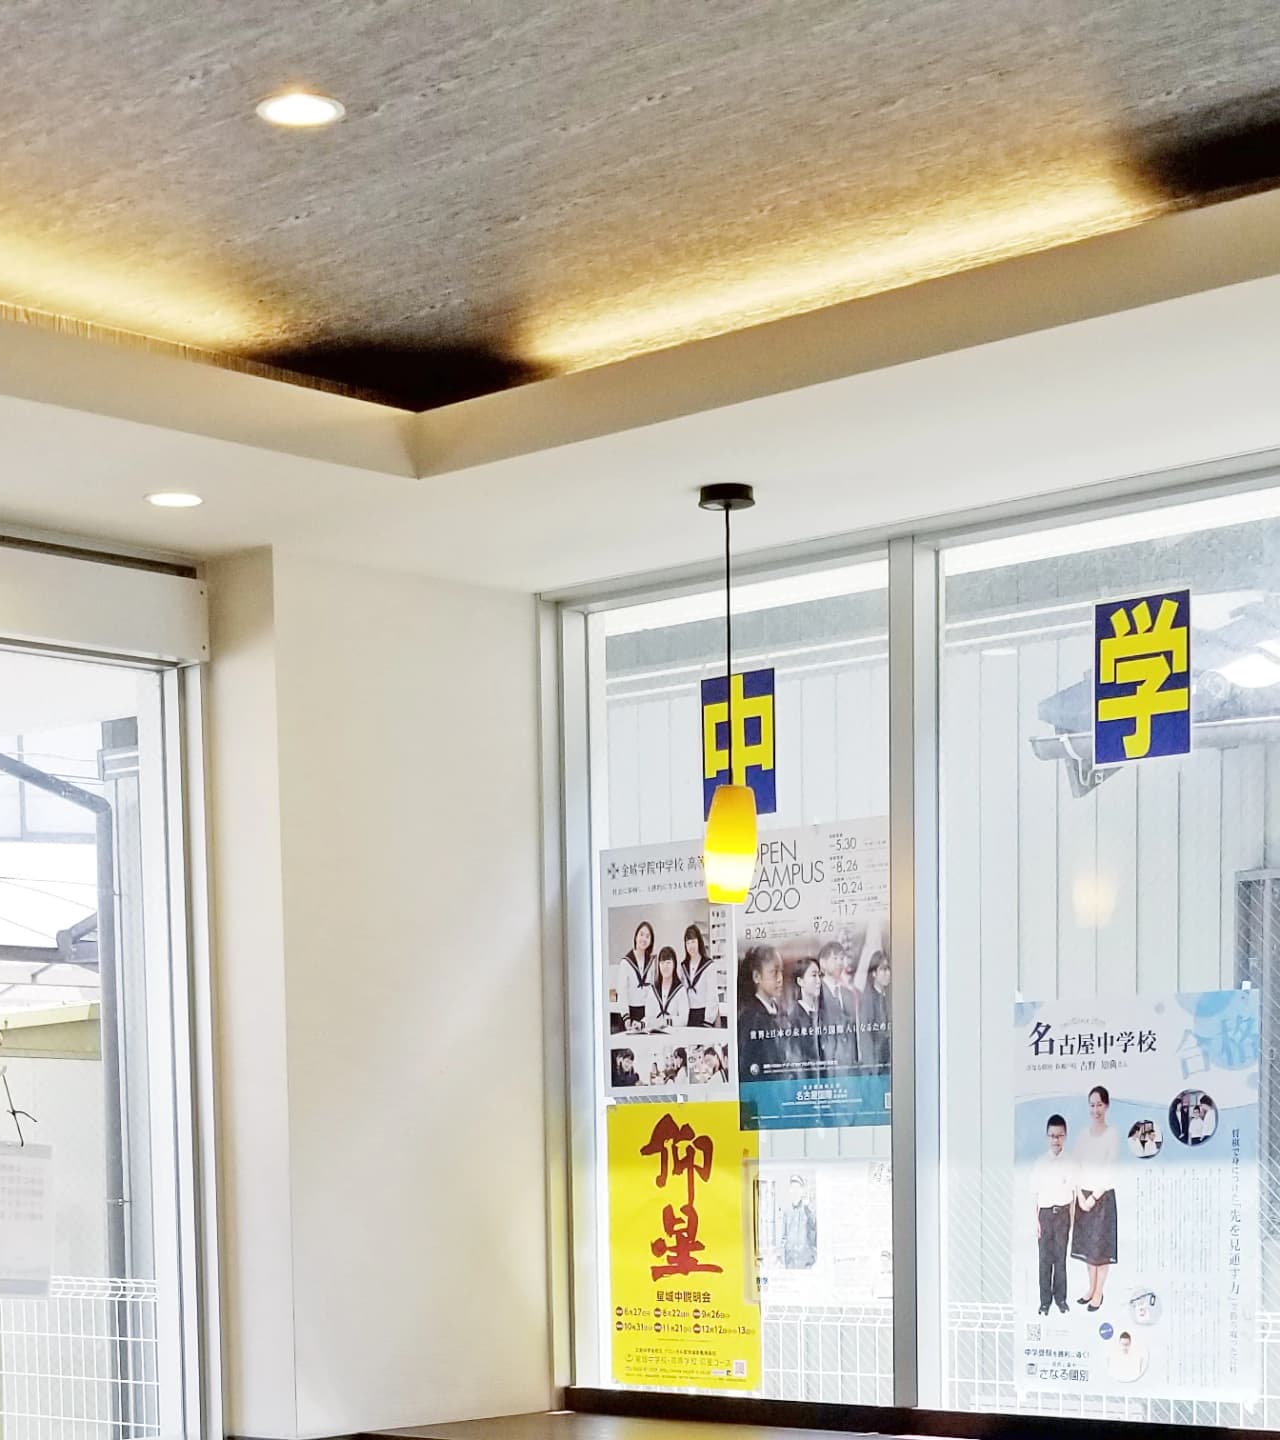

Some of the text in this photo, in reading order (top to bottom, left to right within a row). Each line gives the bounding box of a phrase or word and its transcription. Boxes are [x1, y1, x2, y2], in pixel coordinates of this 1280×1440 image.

[704, 674, 774, 790] 中
[1098, 599, 1188, 758] 学
[757, 840, 797, 865] PEN
[745, 887, 801, 914] 2020
[1028, 1021, 1158, 1056] 名古屋中学校
